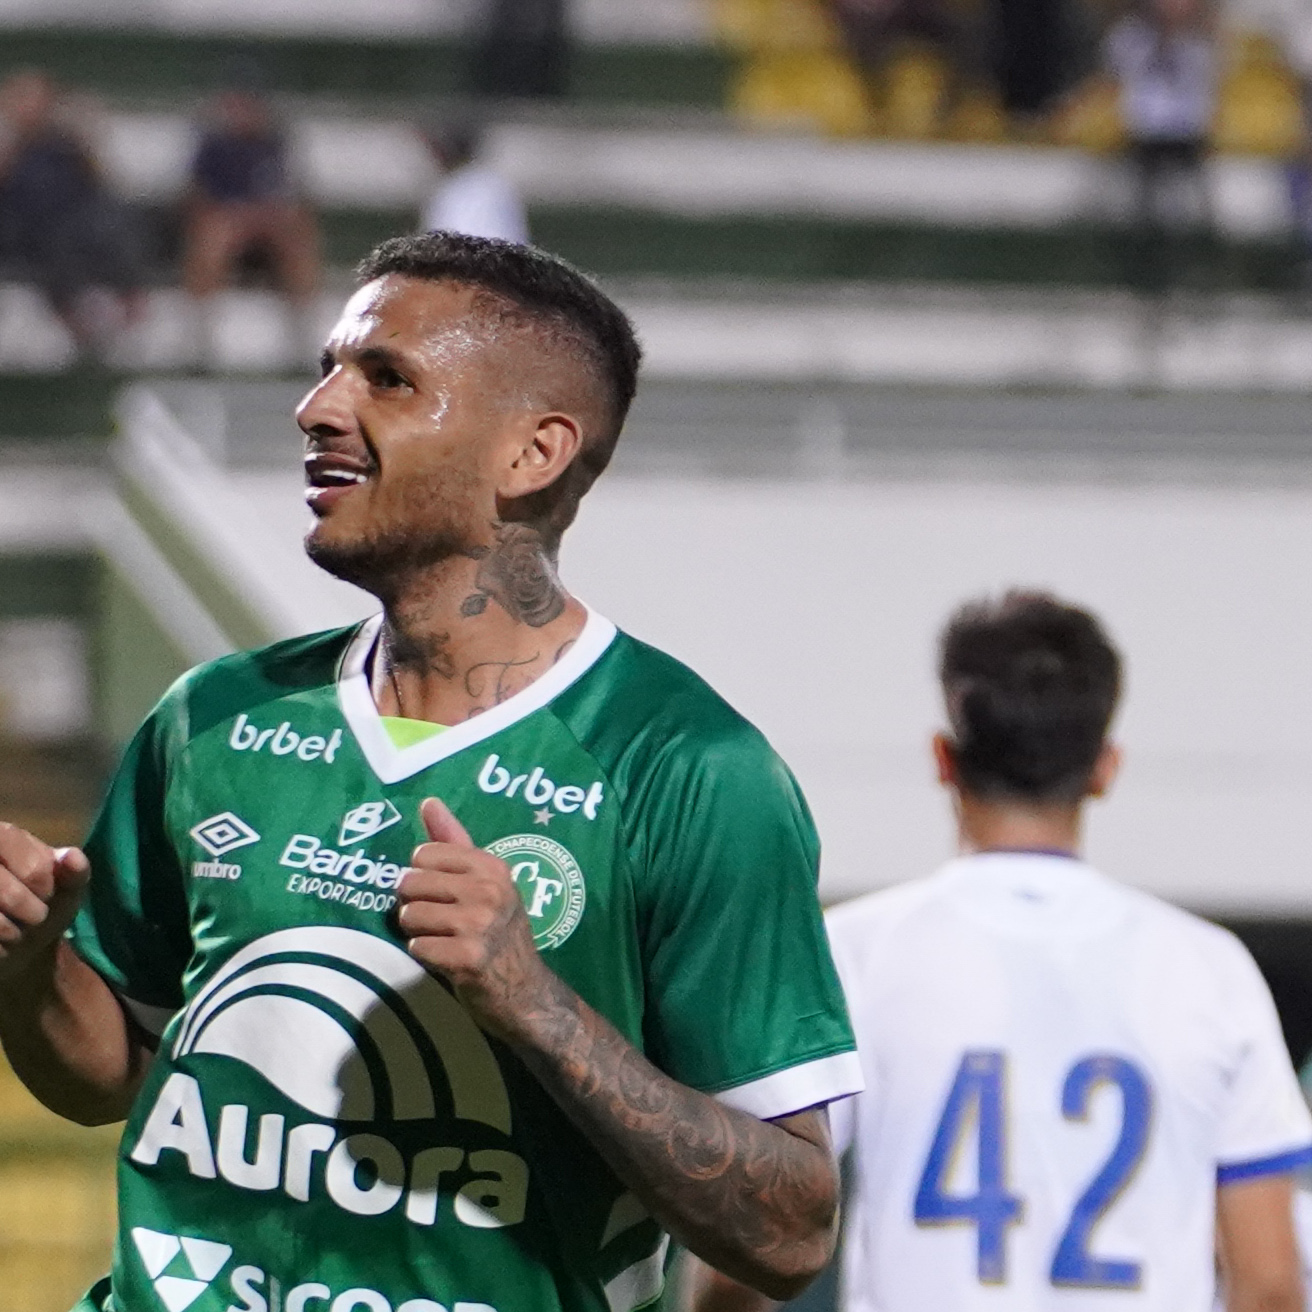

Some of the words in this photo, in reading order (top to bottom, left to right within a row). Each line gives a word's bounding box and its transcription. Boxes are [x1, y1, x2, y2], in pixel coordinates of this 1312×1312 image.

[229, 713, 343, 764] brbet
[477, 753, 604, 821] brbet
[193, 857, 242, 881] umbro
[495, 837, 575, 869] CHAPECOENSE
[557, 888, 584, 937] FUTEBOL
[130, 1072, 530, 1229] Aurora
[911, 1048, 1156, 1291] 42
